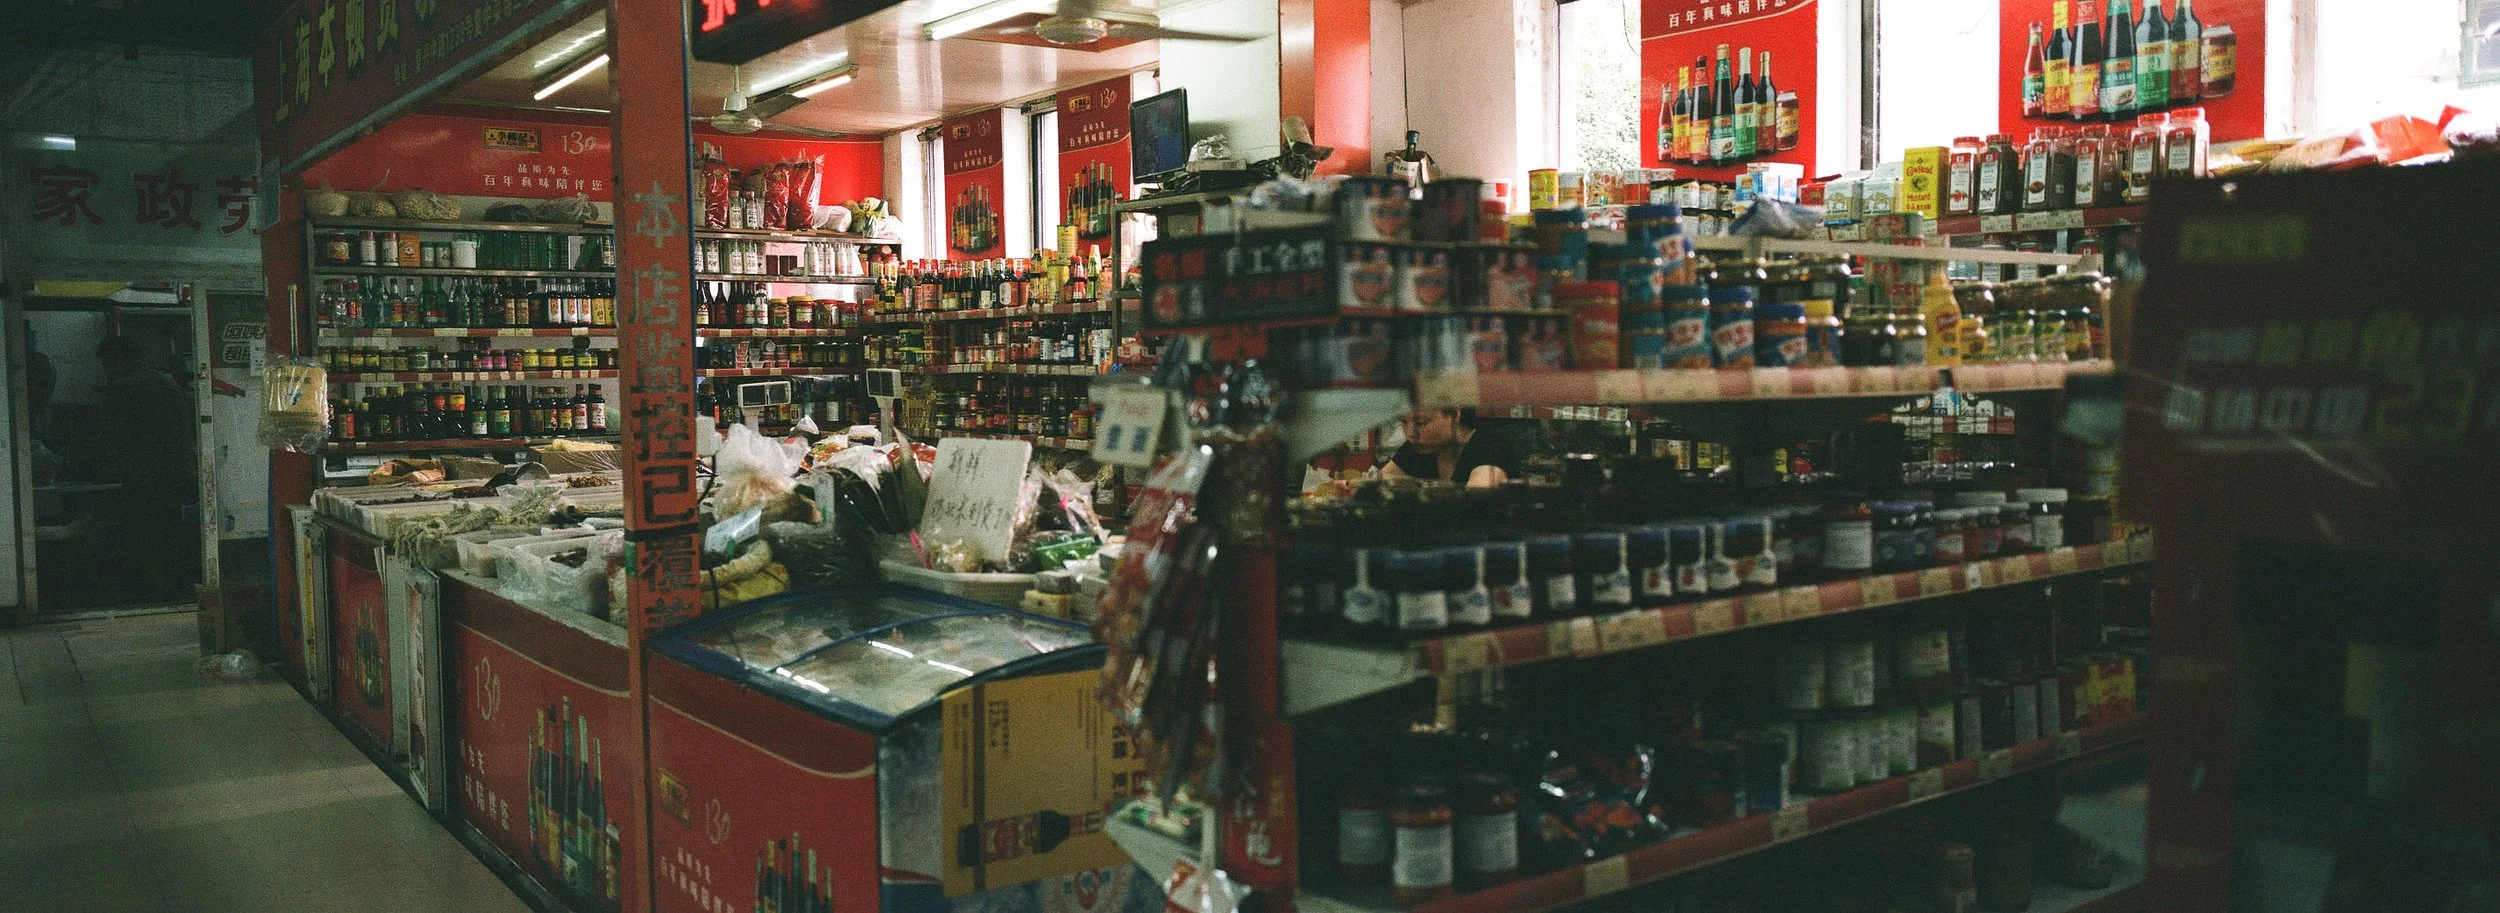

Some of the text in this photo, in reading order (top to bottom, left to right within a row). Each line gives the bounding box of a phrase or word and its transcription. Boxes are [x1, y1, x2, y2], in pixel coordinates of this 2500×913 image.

[562, 131, 597, 155] 130
[518, 163, 570, 176] 品质为先
[484, 174, 603, 191] 百年真味陪伴您
[475, 656, 500, 720] 130
[705, 797, 731, 845] 130
